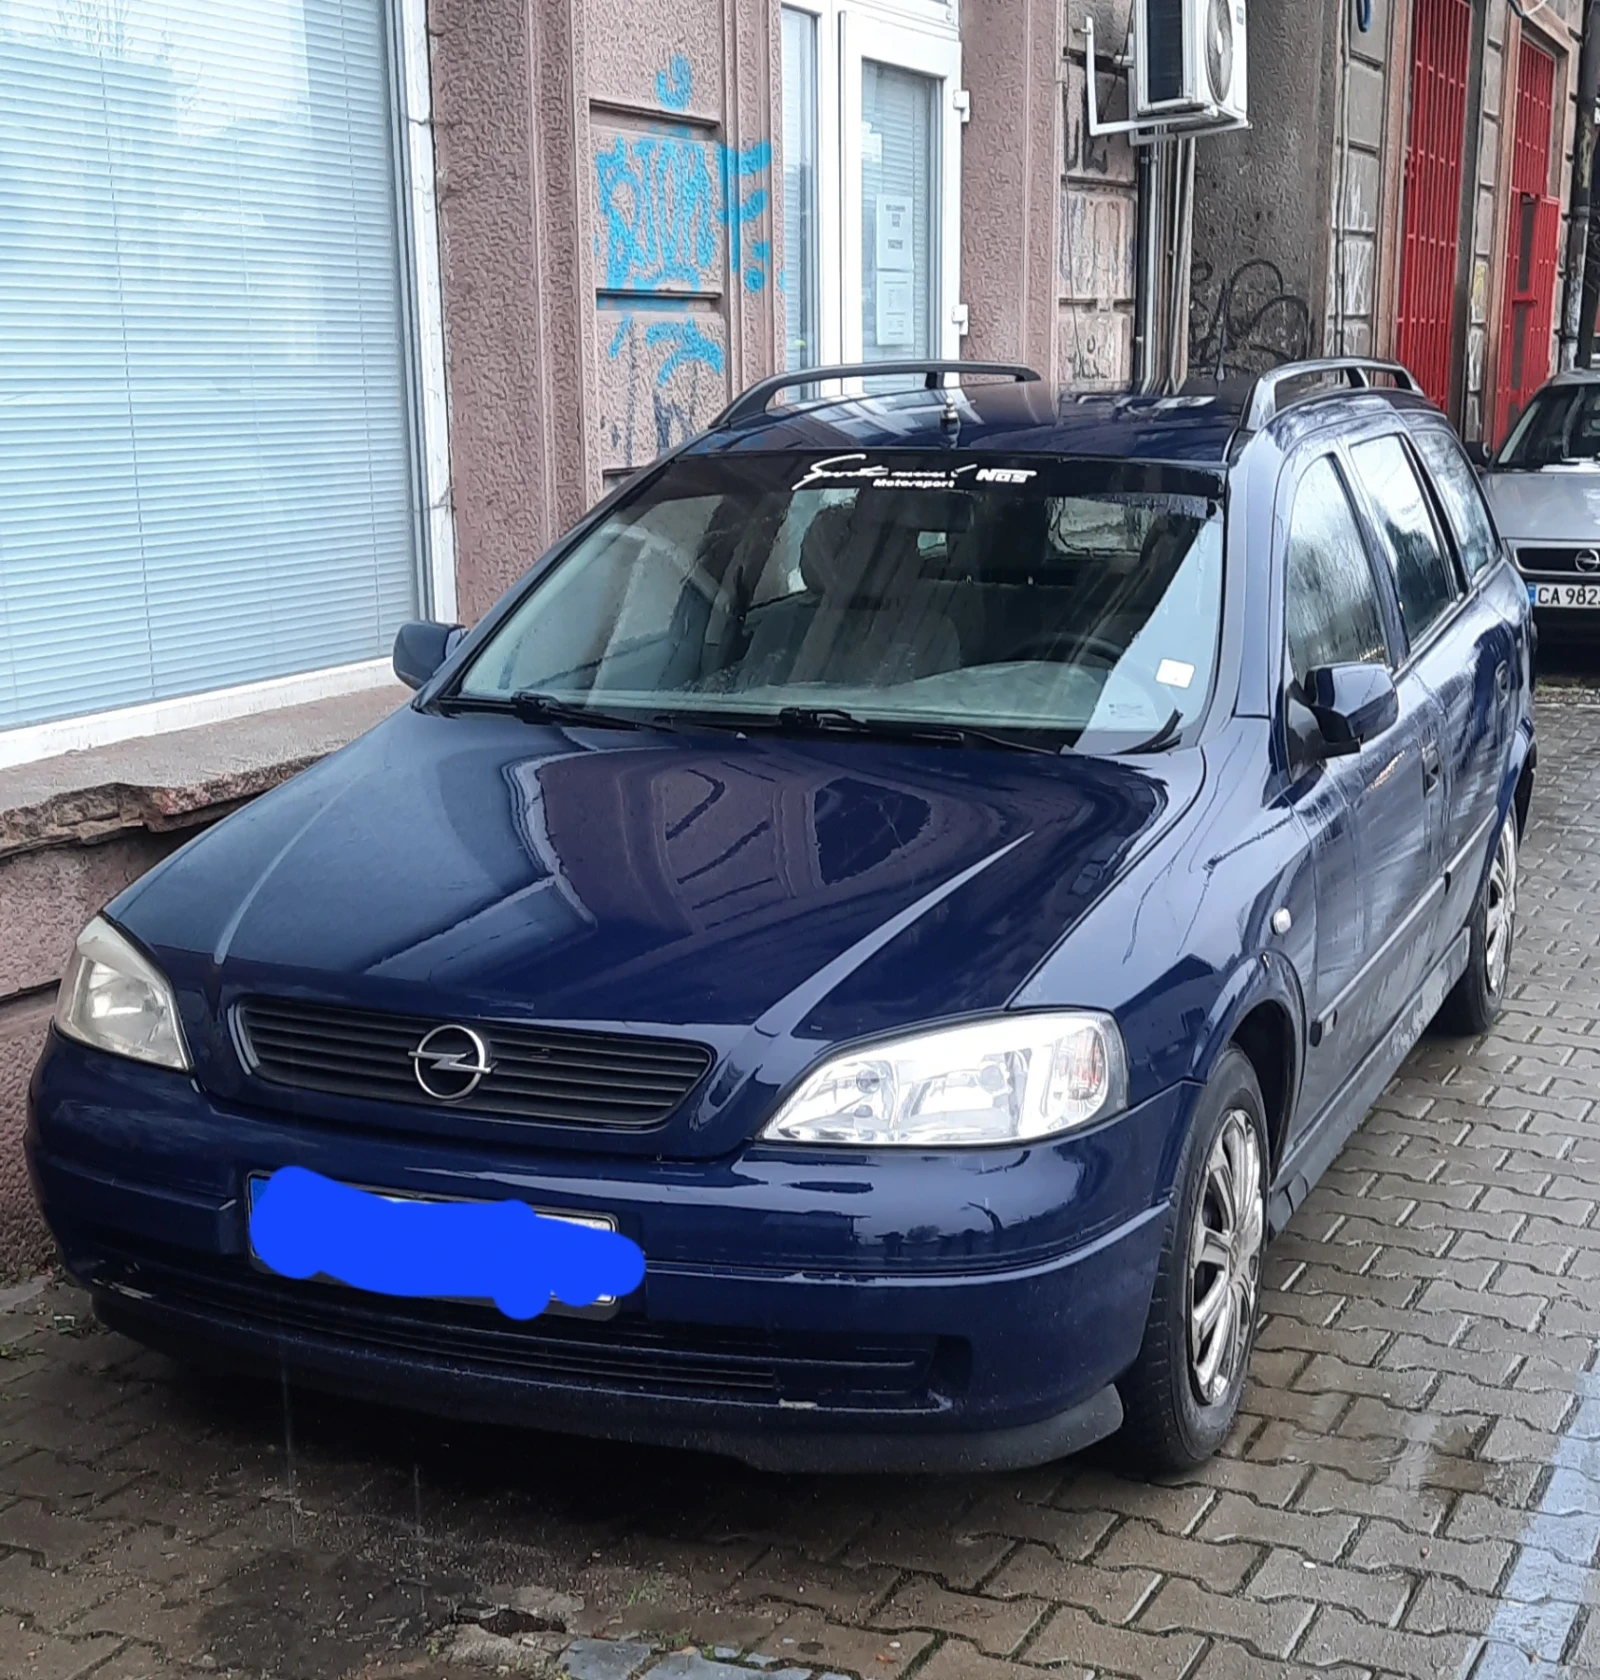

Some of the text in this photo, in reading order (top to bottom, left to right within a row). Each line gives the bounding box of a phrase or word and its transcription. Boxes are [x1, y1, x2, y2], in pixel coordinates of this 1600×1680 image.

[873, 478, 955, 489] Motorsport
[1538, 587, 1600, 606] CA 982
